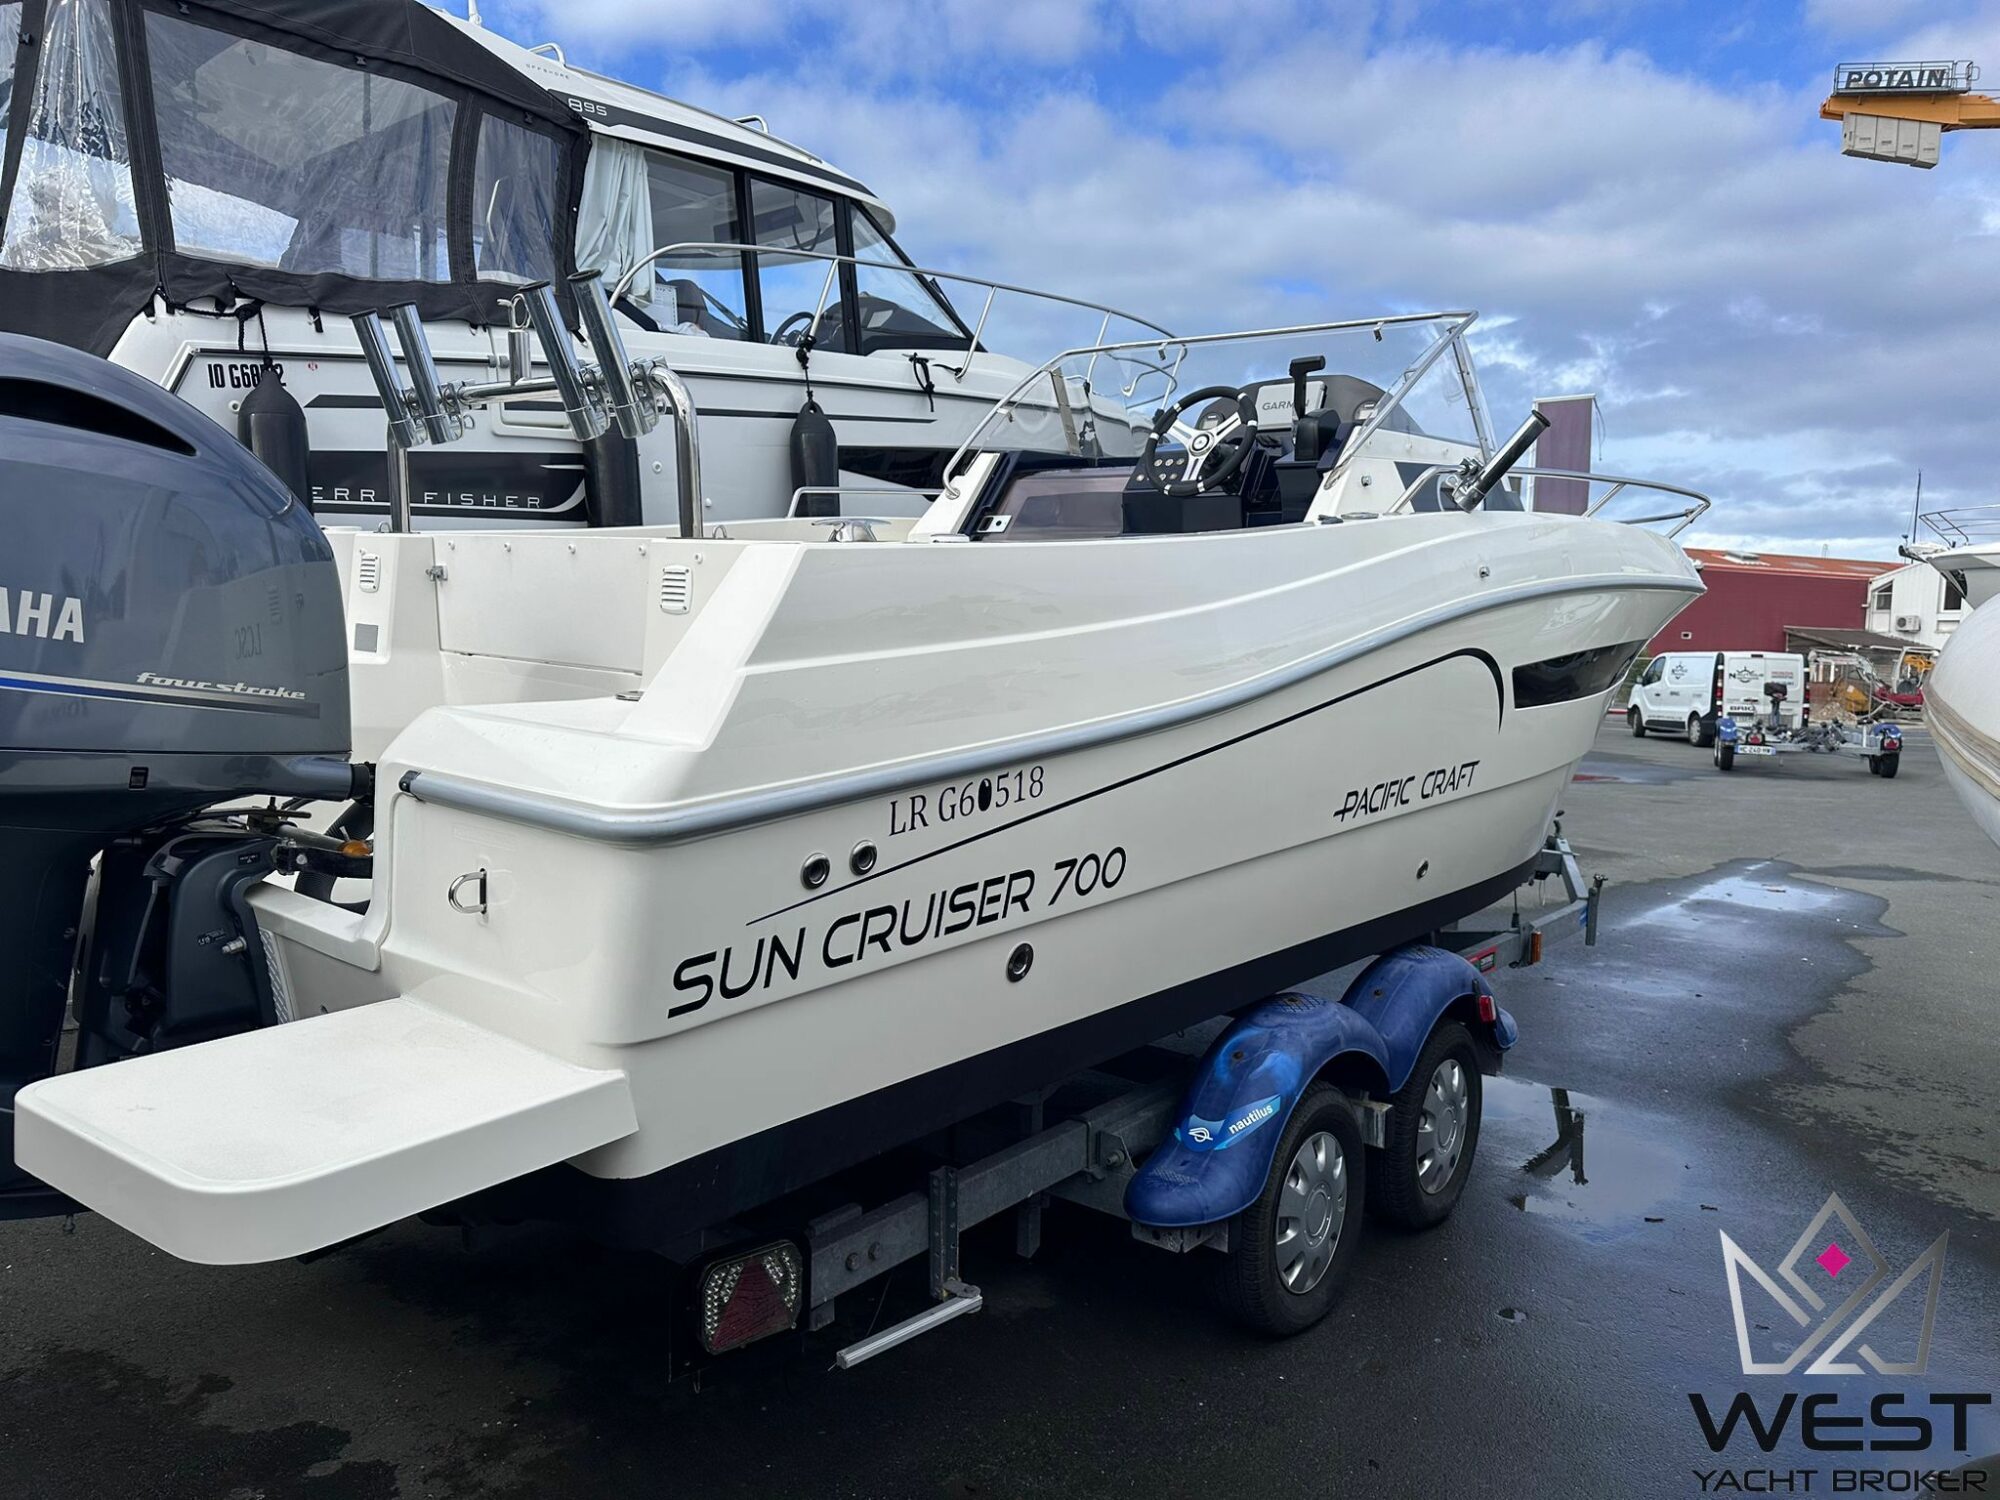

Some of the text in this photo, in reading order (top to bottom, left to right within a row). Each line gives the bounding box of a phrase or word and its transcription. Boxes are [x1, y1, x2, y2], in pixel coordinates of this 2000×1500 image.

[1845, 69, 1947, 89] POTAIN
[568, 98, 607, 116] 895
[1262, 399, 1310, 411] GARM
[424, 491, 541, 509] FISHER
[888, 765, 1045, 836] LR G60518
[1333, 760, 1481, 822] PACIFIC CRAFT
[667, 846, 1127, 1019] SUN CRUISER 700
[1228, 1104, 1274, 1134] nautilus
